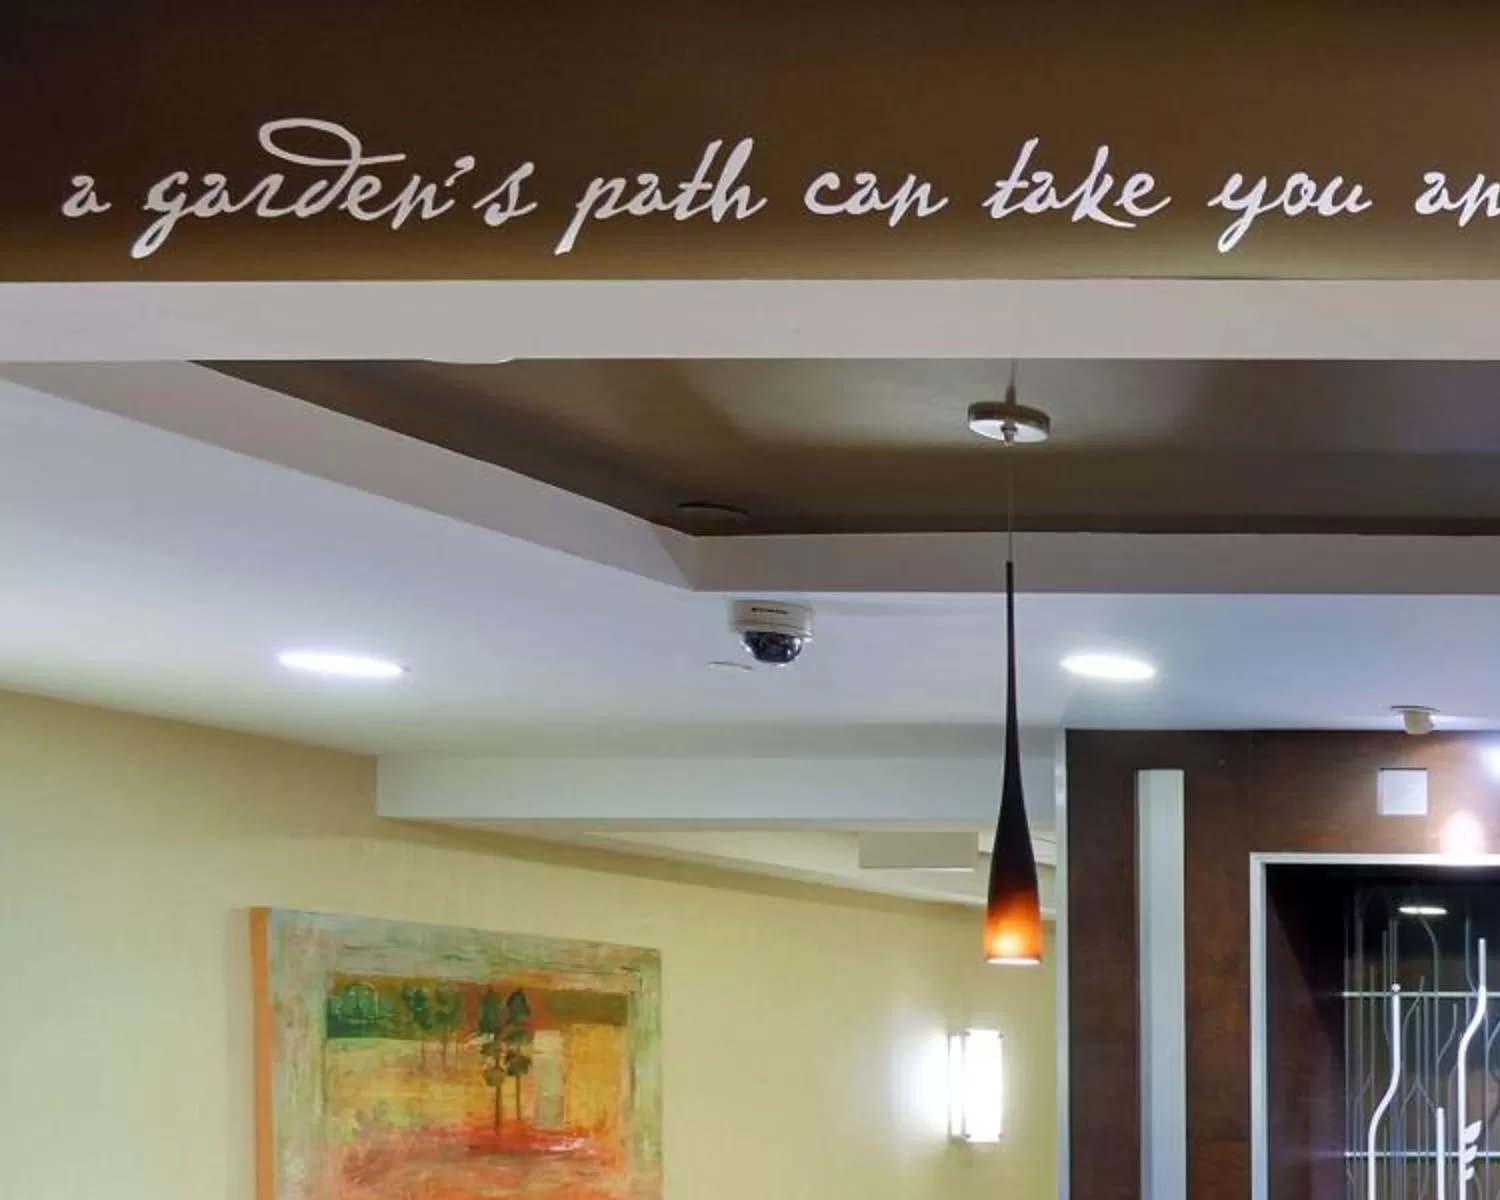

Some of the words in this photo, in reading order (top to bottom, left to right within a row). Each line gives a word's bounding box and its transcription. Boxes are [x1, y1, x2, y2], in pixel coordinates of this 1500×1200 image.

[62, 174, 111, 218] a
[131, 118, 538, 260] garden's
[554, 137, 767, 256] path
[803, 172, 949, 229] can
[982, 137, 1171, 229] take
[1207, 172, 1373, 255] you
